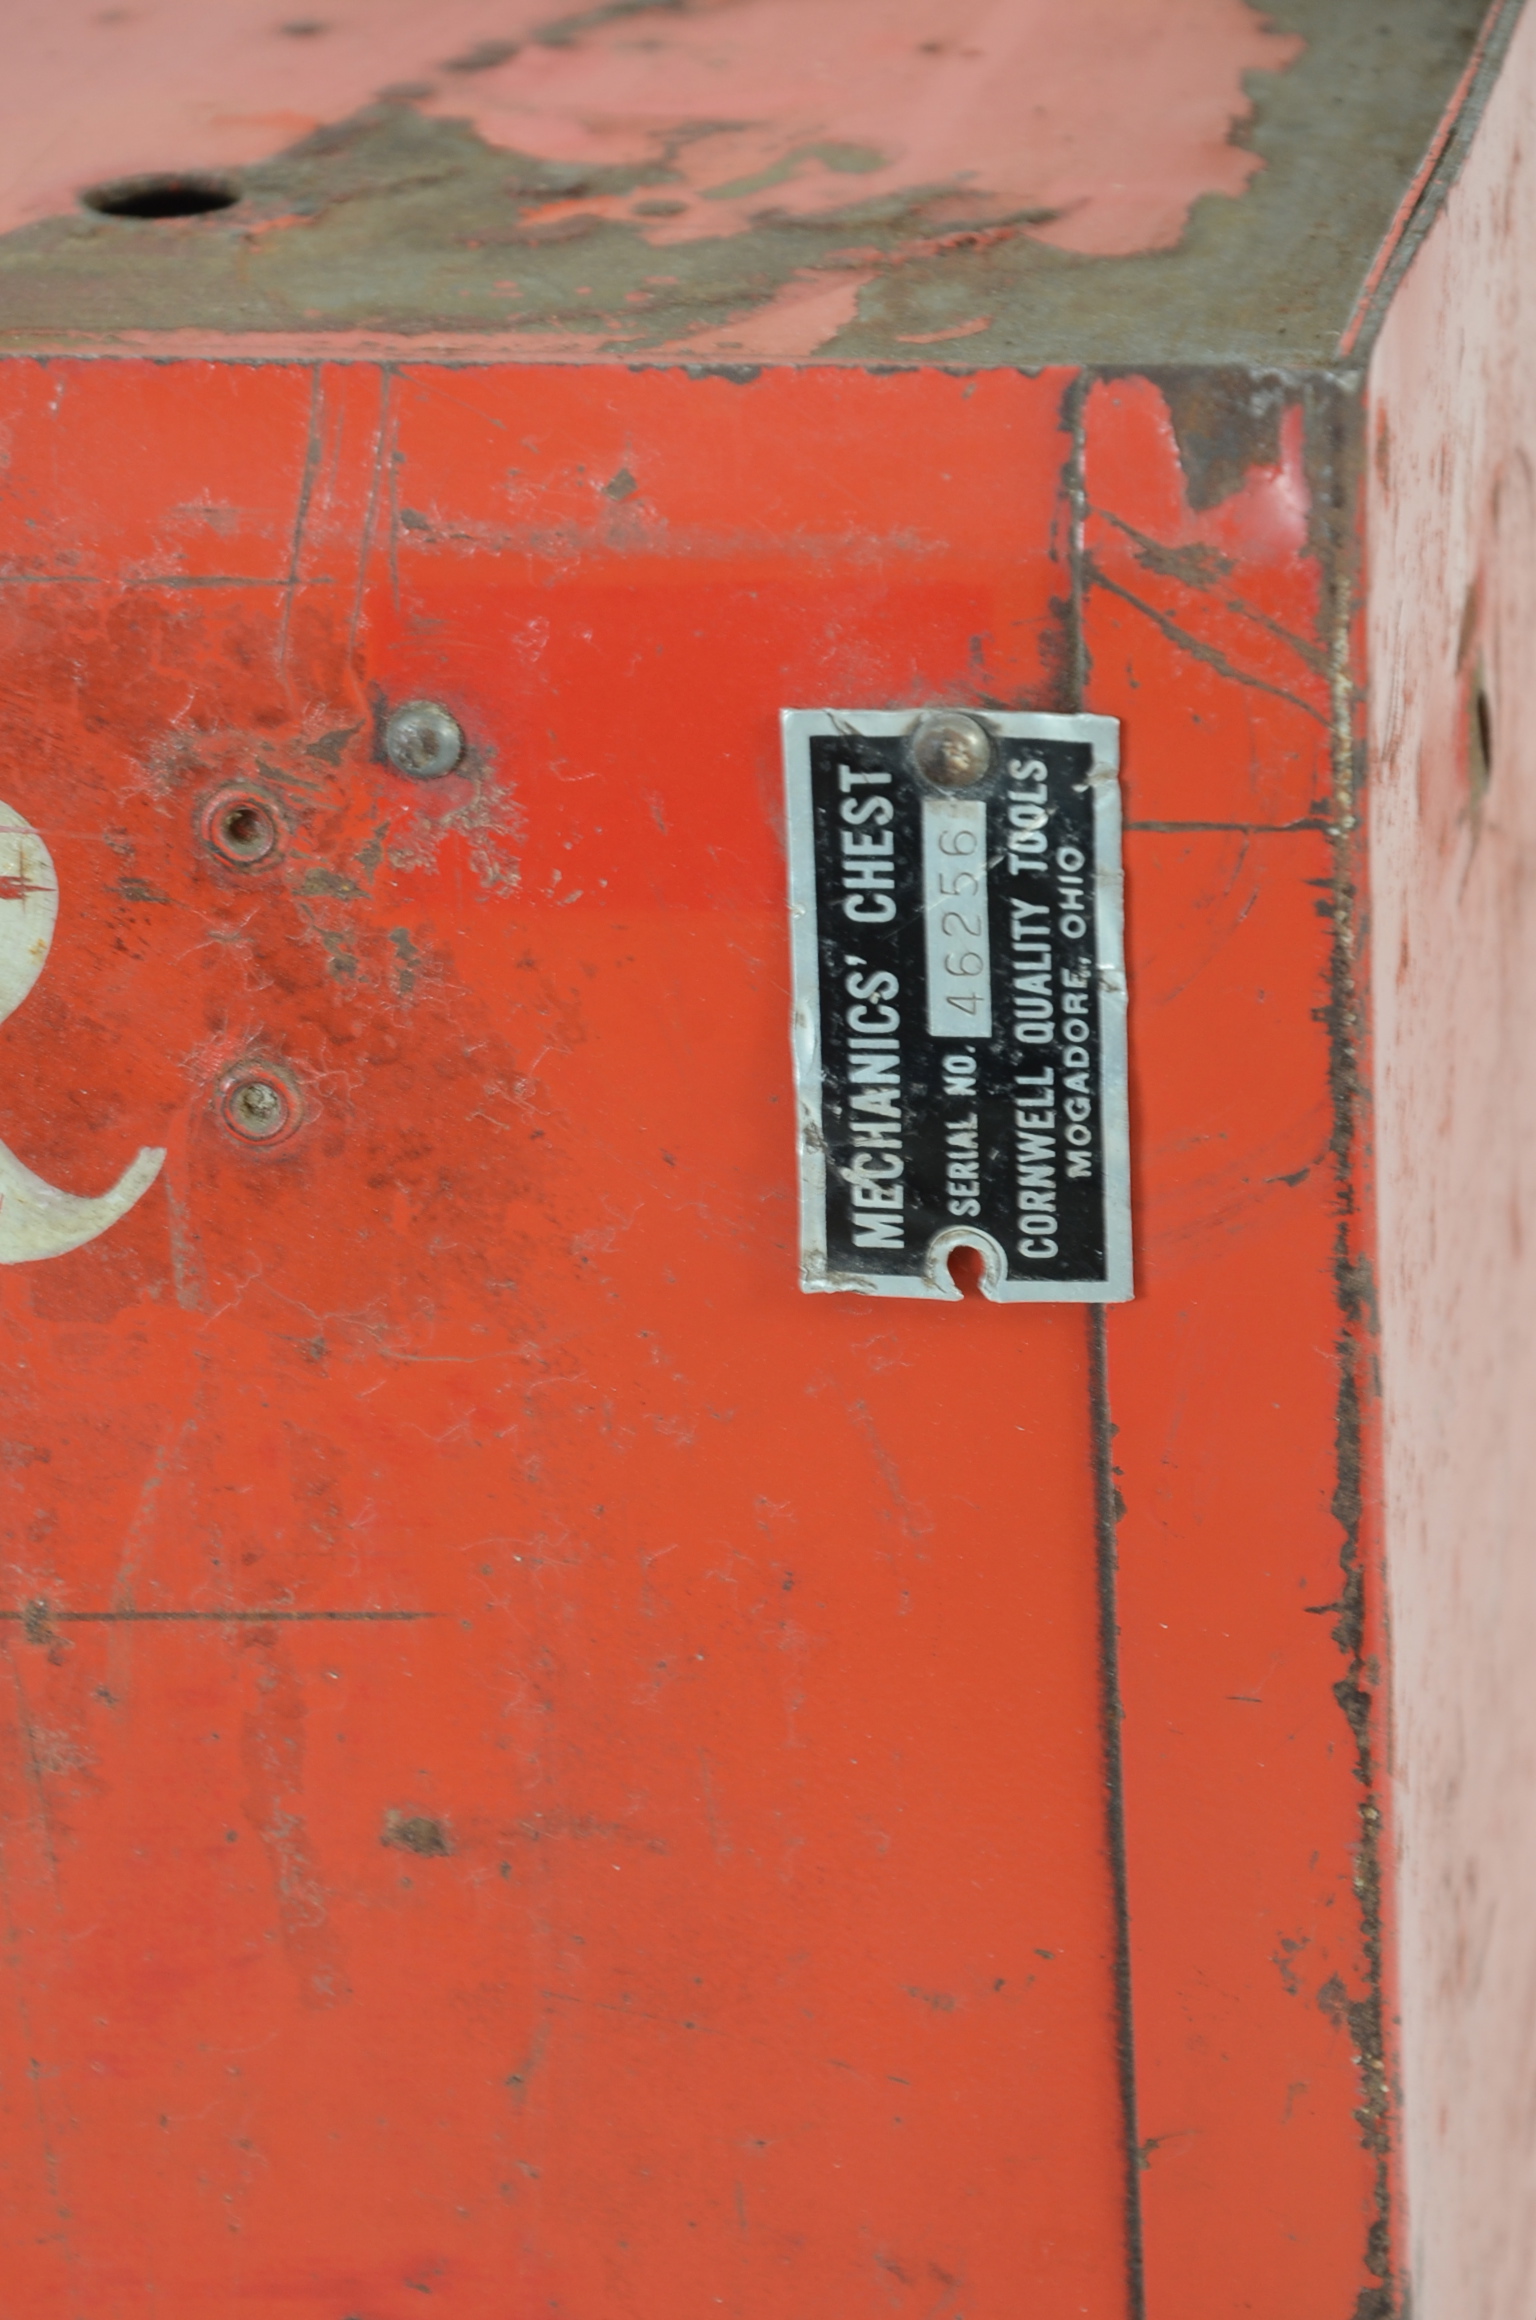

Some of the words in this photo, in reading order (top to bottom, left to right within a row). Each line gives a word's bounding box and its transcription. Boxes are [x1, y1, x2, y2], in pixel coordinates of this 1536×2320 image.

[839, 764, 897, 923] CHEST
[1008, 758, 1049, 875] TOOLS
[938, 830, 985, 1015] 46256
[1056, 847, 1087, 939] OHIO
[1010, 898, 1055, 1044] QUALITY
[845, 954, 905, 1249] MECHANICS'
[942, 1045, 977, 1096] NO.
[1061, 957, 1092, 1178] MOGADORE,
[945, 1112, 981, 1217] SERIAL
[1015, 1066, 1058, 1259] CORNWELL
